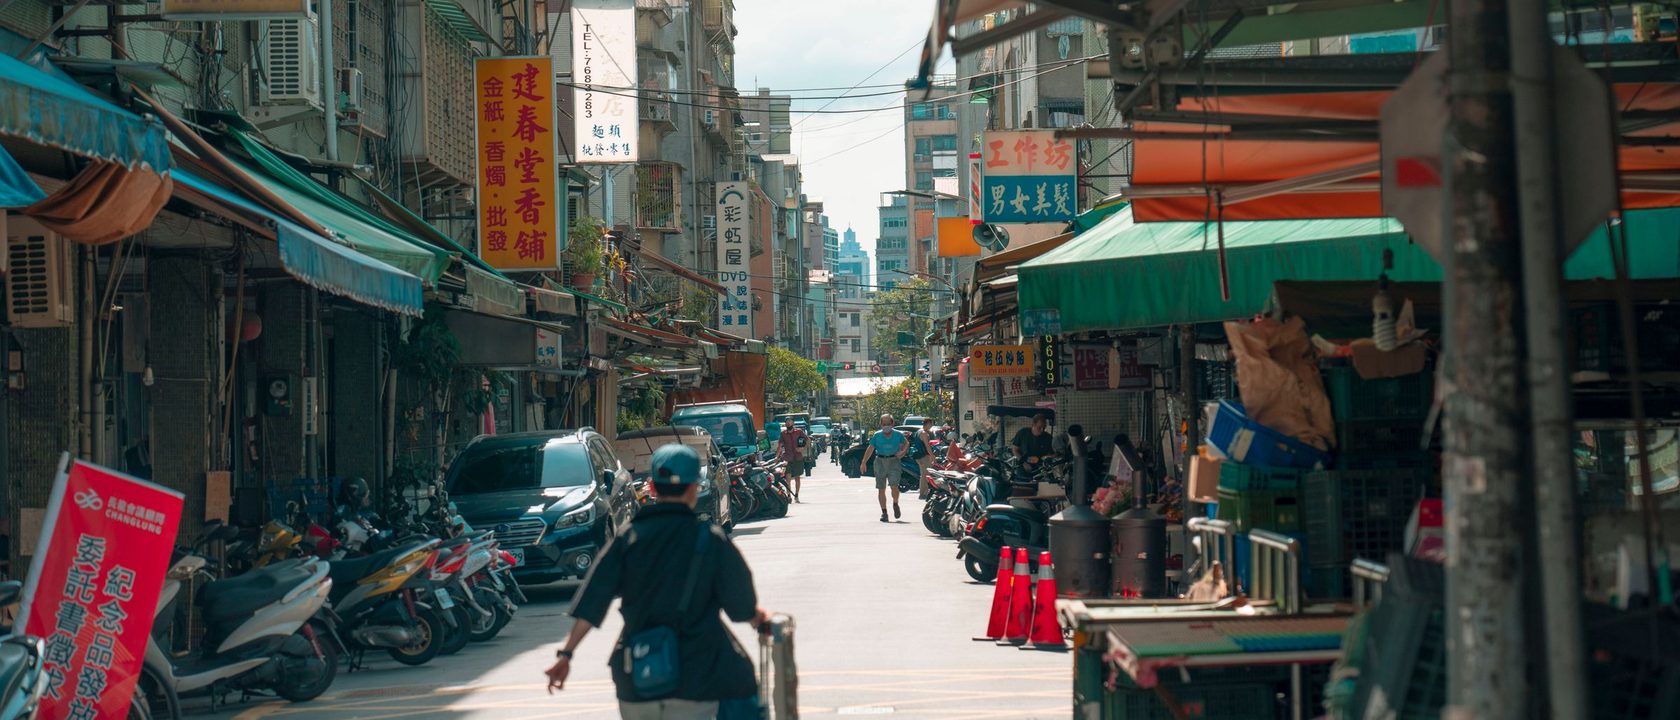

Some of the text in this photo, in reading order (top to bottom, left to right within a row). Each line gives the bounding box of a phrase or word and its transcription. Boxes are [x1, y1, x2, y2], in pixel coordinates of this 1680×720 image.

[511, 63, 548, 262] 建春堂香舖
[987, 135, 1072, 171] 工作坊
[989, 181, 1072, 216] 男女美髮
[724, 206, 742, 265] 彩虹屋
[721, 271, 747, 282] DVD
[105, 509, 162, 535] CHANGLUNG
